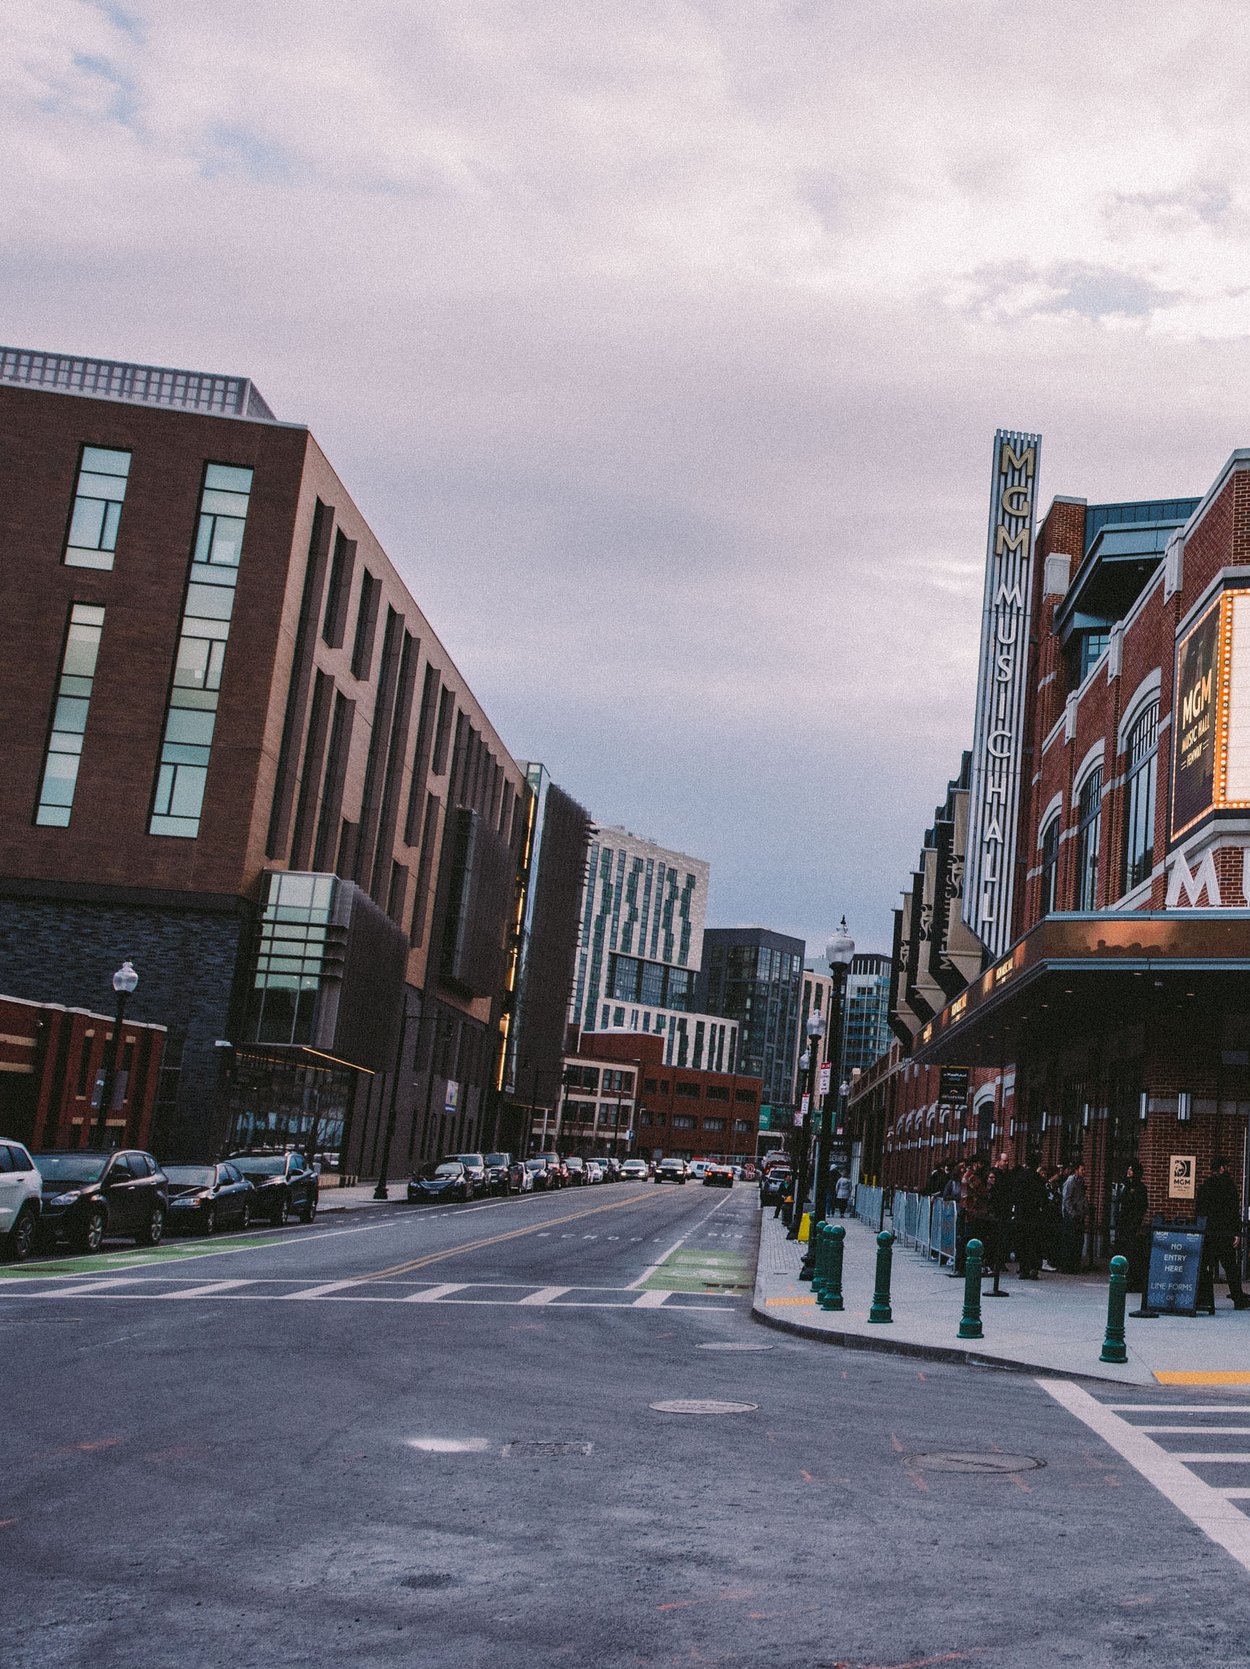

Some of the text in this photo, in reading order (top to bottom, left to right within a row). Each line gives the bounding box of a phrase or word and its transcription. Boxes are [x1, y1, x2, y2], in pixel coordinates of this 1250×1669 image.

[996, 443, 1034, 560] MGM
[986, 583, 1022, 759] MUSIC
[1182, 668, 1213, 730] MGM
[1181, 719, 1210, 754] MUSIC HALL
[982, 774, 1008, 922] HALL
[536, 1231, 666, 1244] SCHOOL
[1163, 1253, 1187, 1262] ENTRY
[1164, 1265, 1184, 1273] HERE
[1150, 1282, 1193, 1292] LINE FORMS
